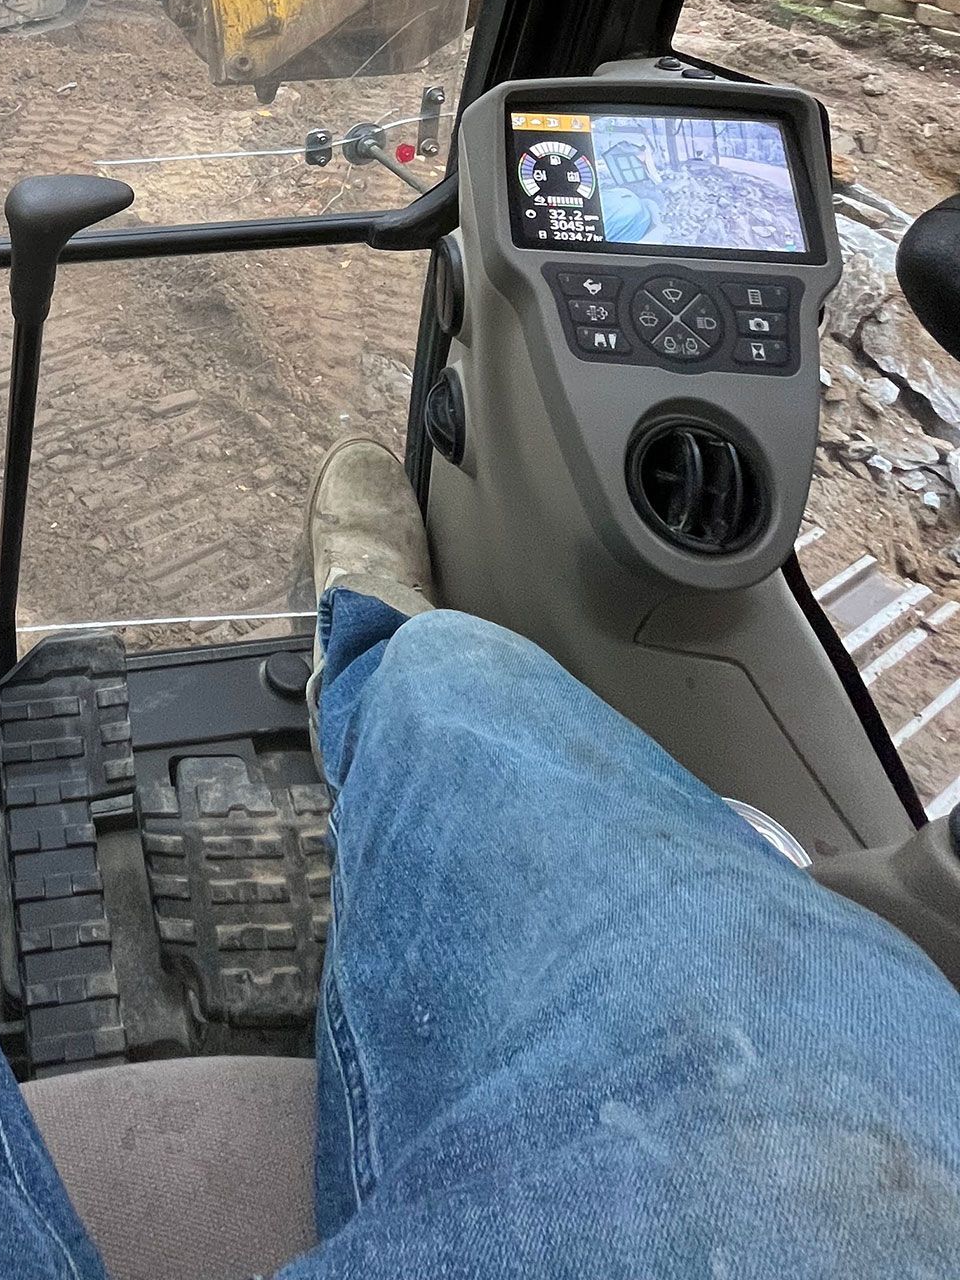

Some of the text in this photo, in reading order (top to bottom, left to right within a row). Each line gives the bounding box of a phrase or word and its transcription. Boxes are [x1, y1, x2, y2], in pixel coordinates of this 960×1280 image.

[549, 209, 582, 220] 32.2
[550, 220, 584, 231] 3045
[554, 232, 593, 241] 2034.7
